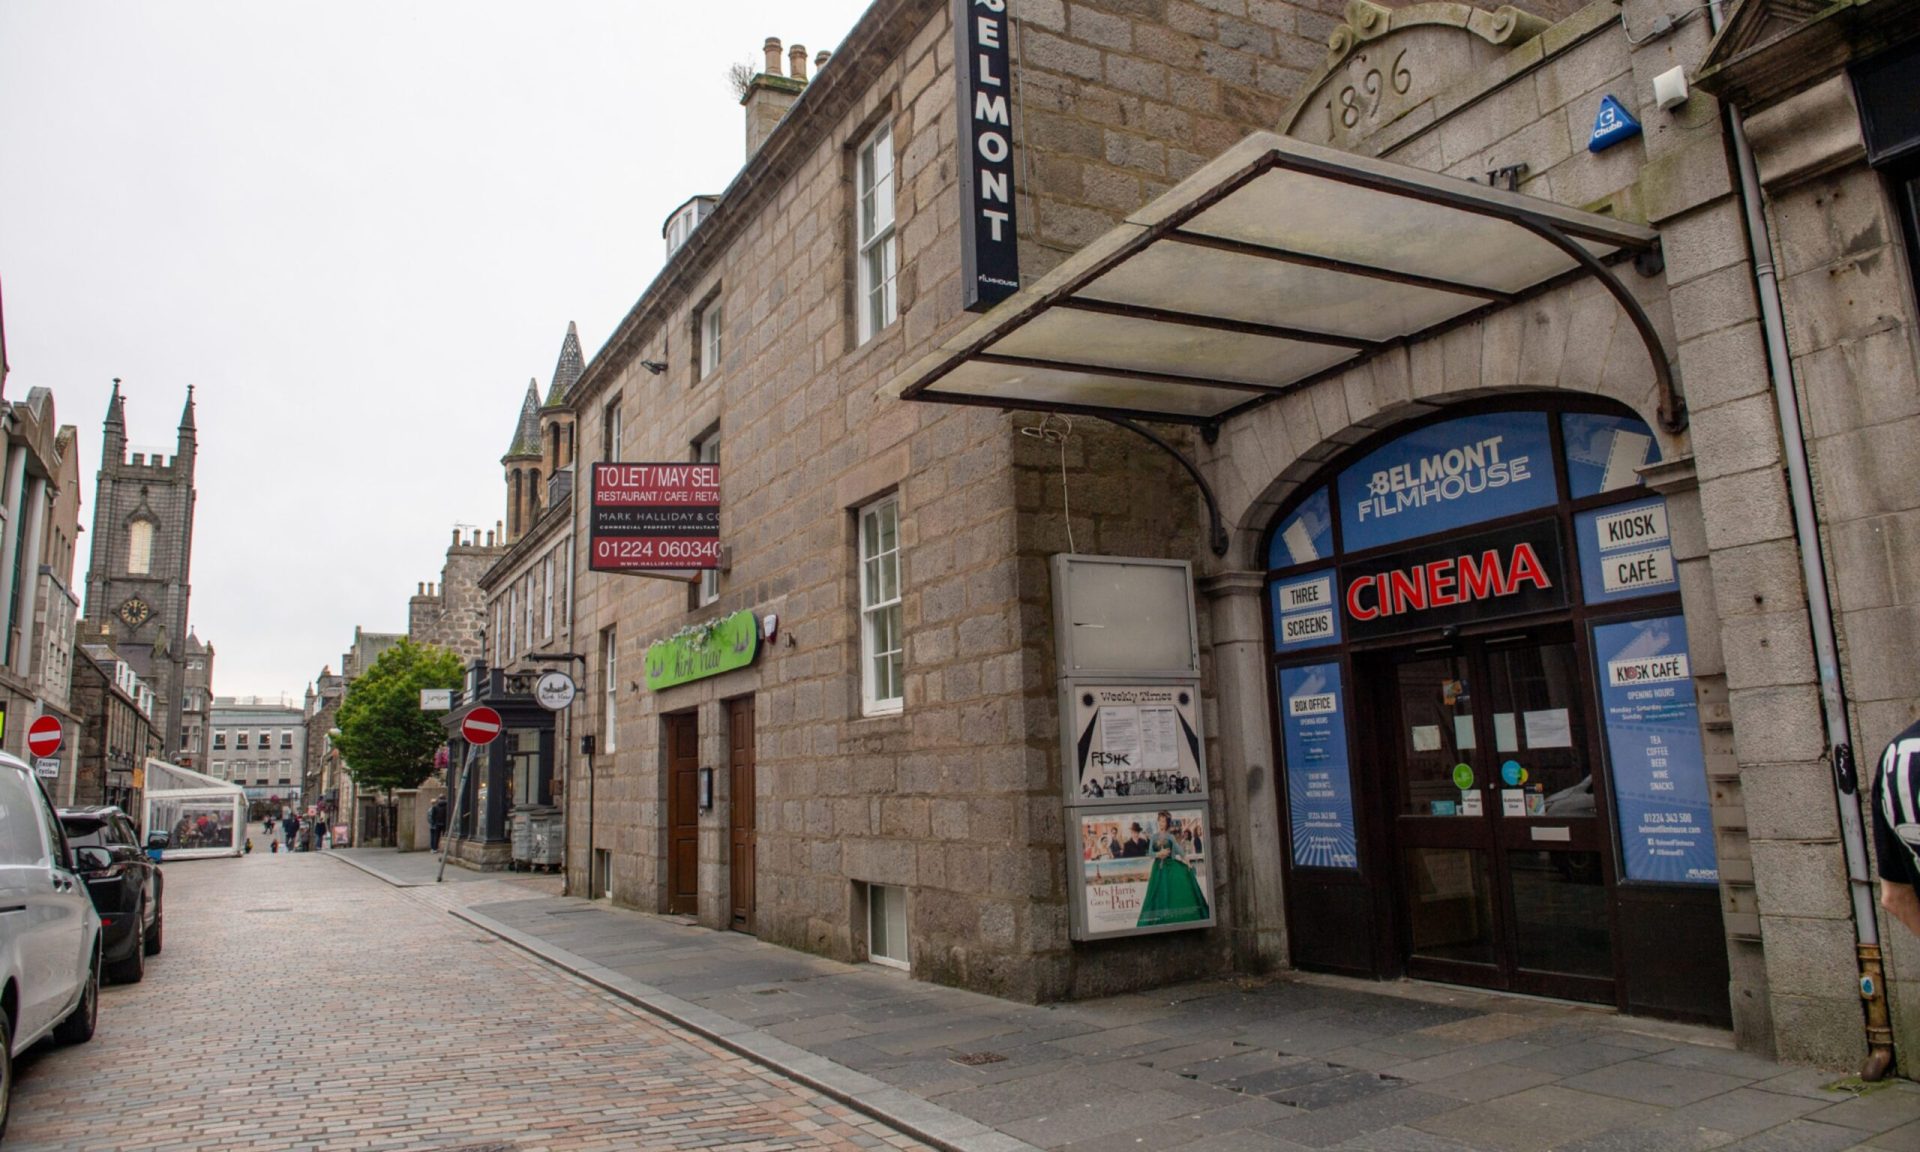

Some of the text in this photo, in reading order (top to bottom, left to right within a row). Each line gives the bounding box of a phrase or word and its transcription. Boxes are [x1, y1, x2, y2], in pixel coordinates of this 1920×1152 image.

[1325, 47, 1412, 142] 1896
[1594, 121, 1623, 139] Chubb
[1366, 435, 1503, 496] BELMONT
[598, 467, 619, 488] TO
[621, 467, 649, 487] LET
[658, 467, 689, 487] MAY
[691, 467, 720, 488] SEL
[597, 491, 657, 501] RESTAURANT
[664, 491, 688, 501] CAFE
[1358, 456, 1531, 522] FILMHOUSE
[599, 512, 632, 521] MARK
[636, 512, 694, 521] HALLIDAY
[697, 512, 704, 521] &
[1608, 513, 1656, 542] KIOSK
[598, 541, 721, 558] 01224 060340
[1618, 554, 1657, 584] CAFÉ
[1346, 542, 1553, 621] CINEMA
[1290, 585, 1319, 605] THREE
[1287, 616, 1328, 637] SCREENS
[1651, 657, 1680, 680] CAFÉ
[1100, 690, 1172, 703] Weekly Times
[1627, 687, 1675, 700] OPENING HOURS
[1294, 697, 1331, 712] BOX OFFICE
[1650, 735, 1661, 745] TEA
[1646, 746, 1669, 756] COFFEE
[1651, 758, 1667, 768] BEER
[1652, 770, 1669, 779] WINE
[1650, 781, 1675, 791] SNACKS
[1643, 813, 1664, 823] 01224
[1665, 813, 1678, 823] 343
[1111, 894, 1140, 910] Paris
